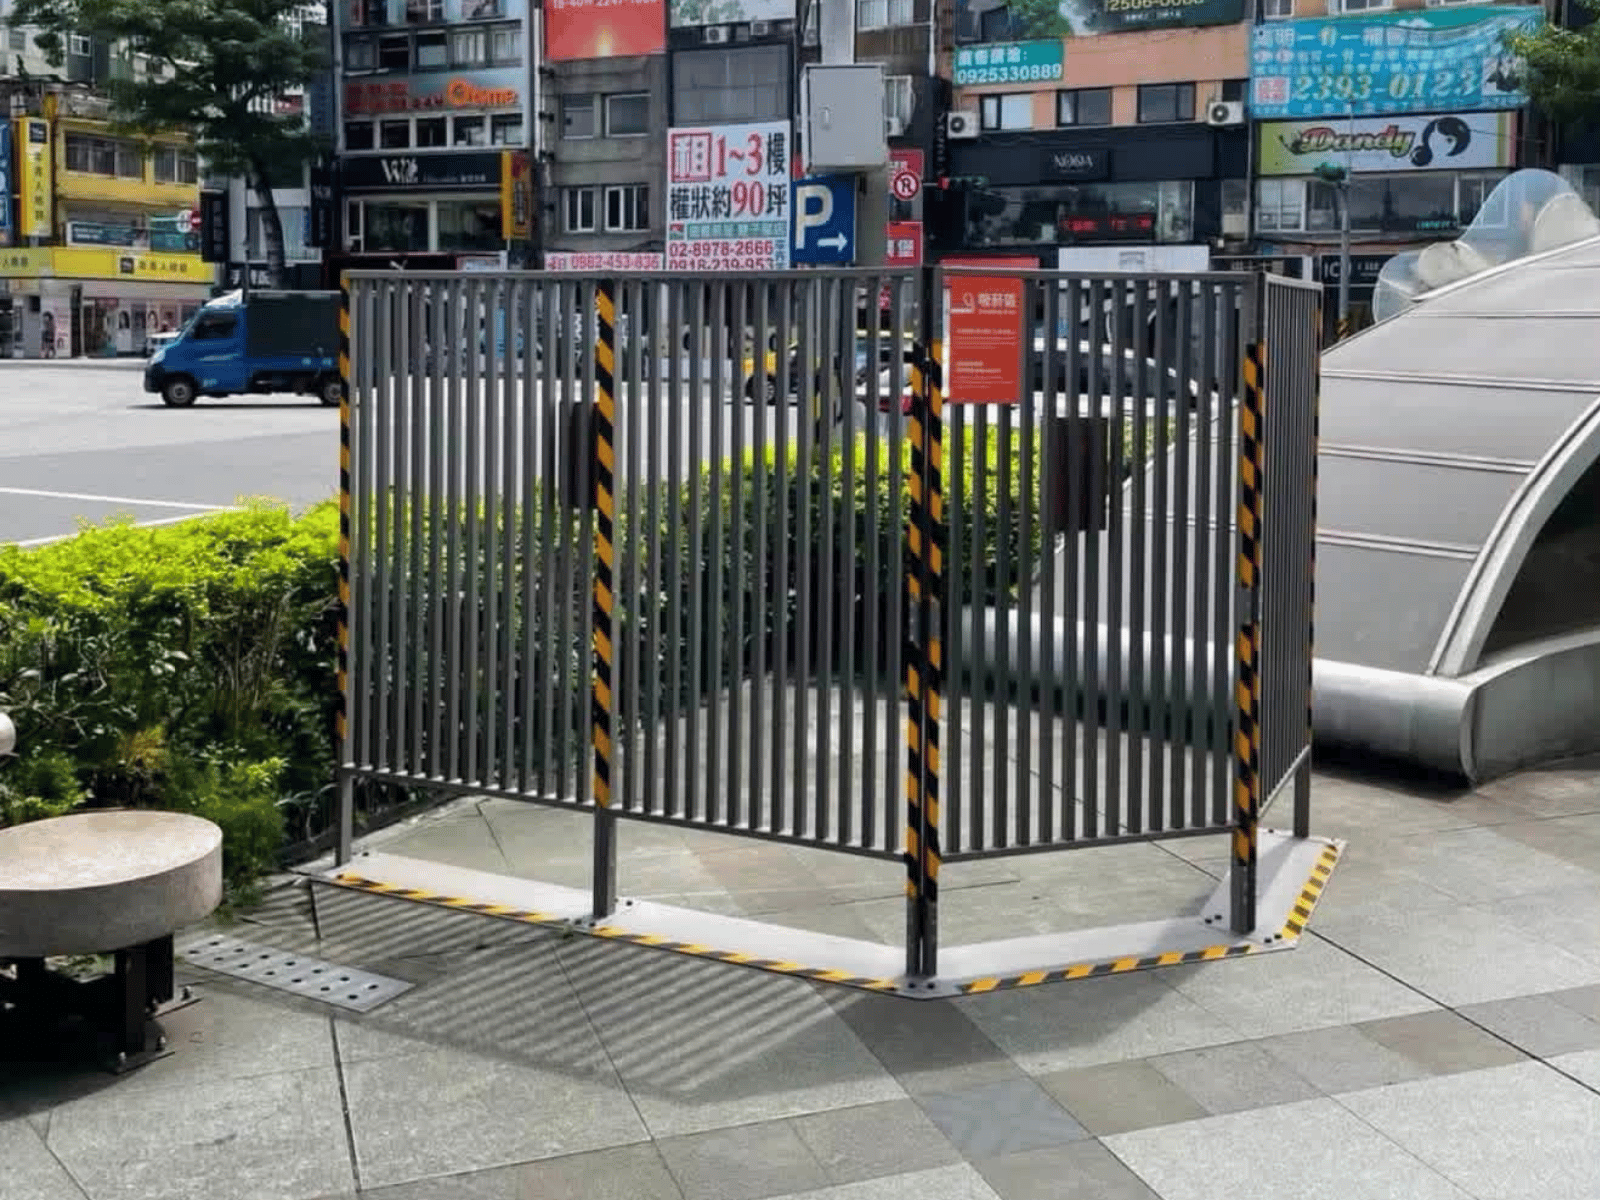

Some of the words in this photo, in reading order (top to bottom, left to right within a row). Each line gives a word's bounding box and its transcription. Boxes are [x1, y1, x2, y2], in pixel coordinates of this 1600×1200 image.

[957, 63, 1062, 84] 0925330889
[1293, 69, 1477, 100] 2393-0123
[1301, 126, 1416, 158] Dandy
[670, 181, 787, 220] 權狀約90坪
[796, 185, 833, 249] P
[669, 240, 774, 257] 02-8978-2666
